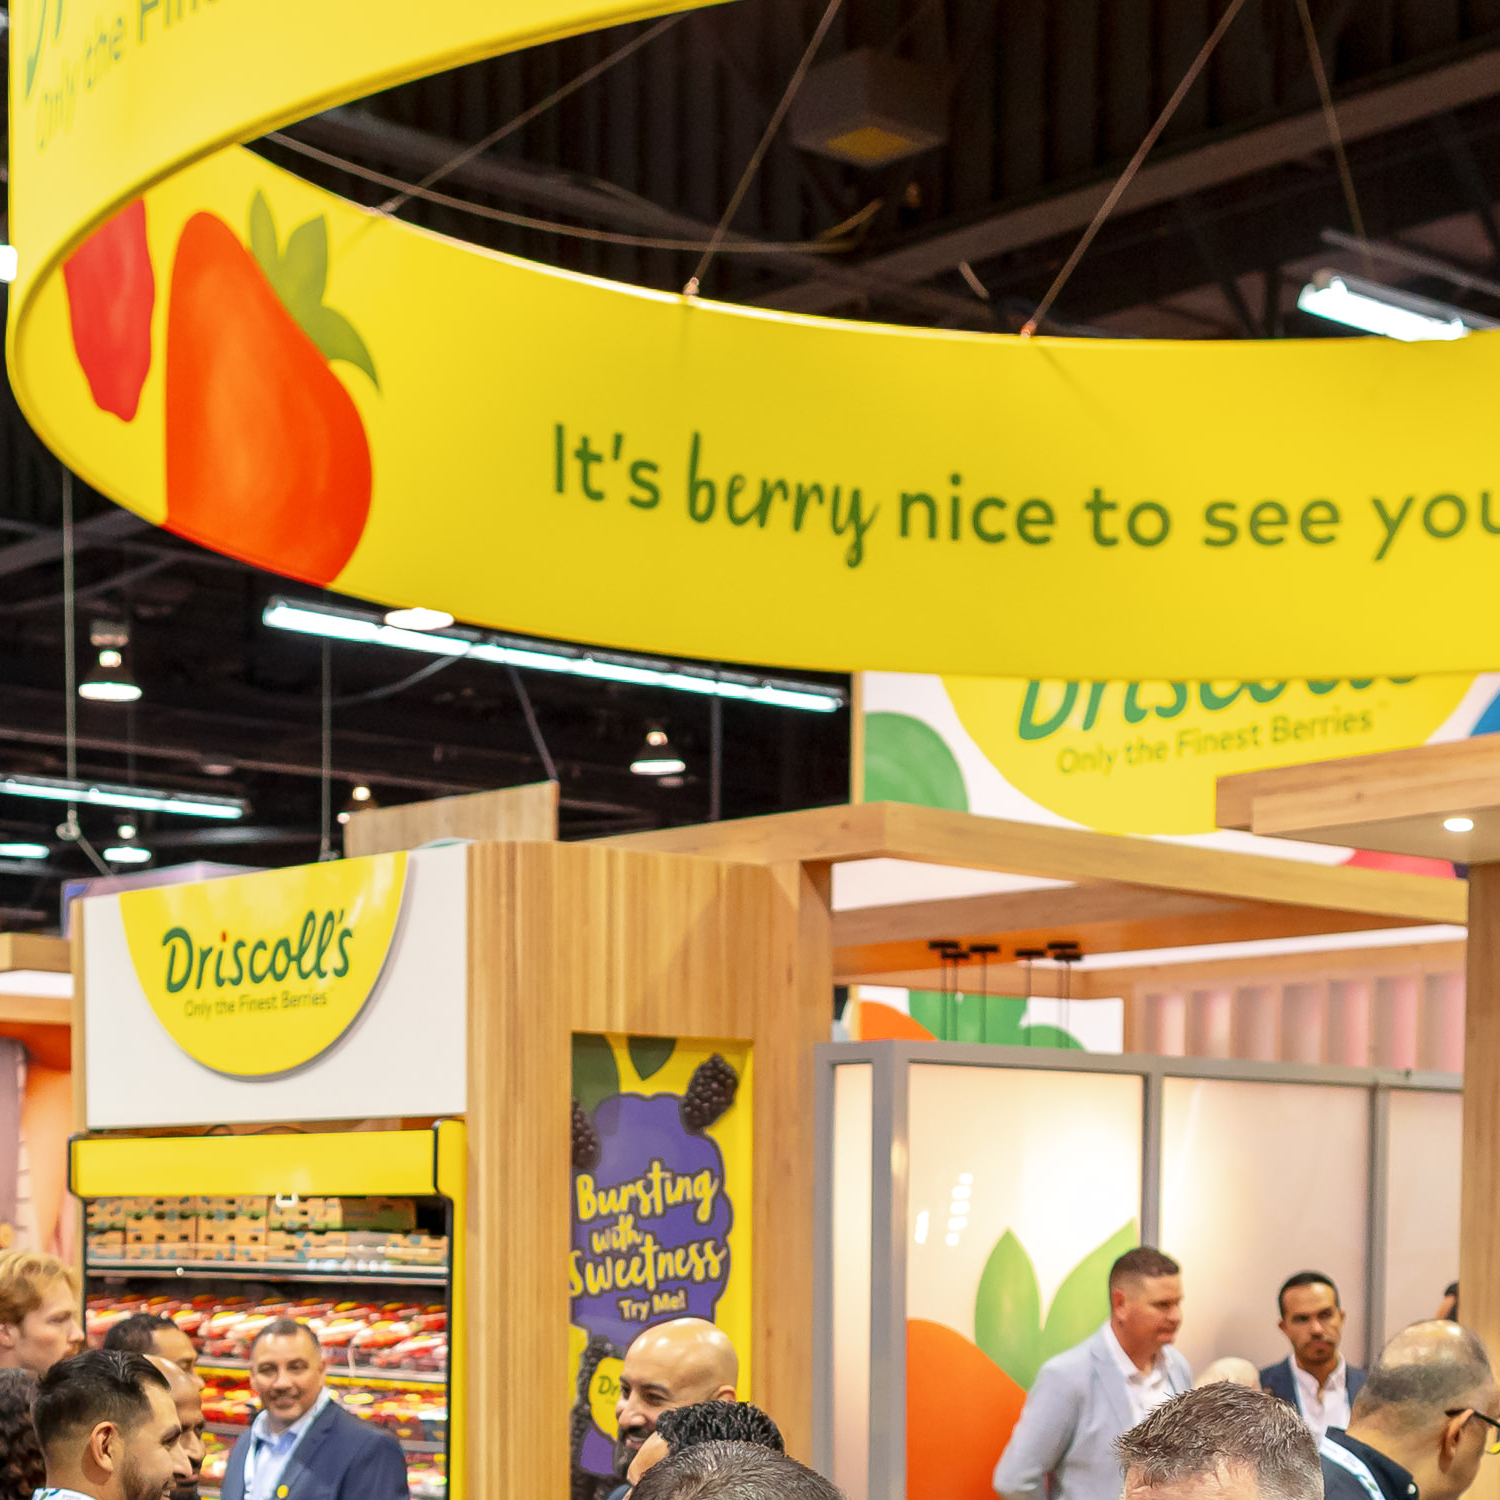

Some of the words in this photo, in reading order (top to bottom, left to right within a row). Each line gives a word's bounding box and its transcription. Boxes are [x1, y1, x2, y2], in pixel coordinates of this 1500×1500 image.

[555, 423, 661, 510] It's
[687, 431, 880, 568] berry
[900, 473, 1056, 545] nice
[1084, 487, 1171, 547] to
[1203, 500, 1340, 547] see
[1056, 742, 1115, 777] Only
[1124, 737, 1167, 767] the
[1175, 722, 1261, 759] Finest
[1271, 706, 1374, 745] Berries
[162, 908, 353, 994] Driscoll's
[184, 998, 213, 1021] Only
[214, 997, 236, 1016] the
[238, 993, 278, 1014] Finest
[281, 988, 328, 1010] Berries
[576, 1160, 719, 1223] Bursting
[569, 1233, 727, 1296] Sweetness
[592, 1213, 643, 1253] with
[619, 1299, 650, 1321] Try
[652, 1289, 686, 1313] Me!
